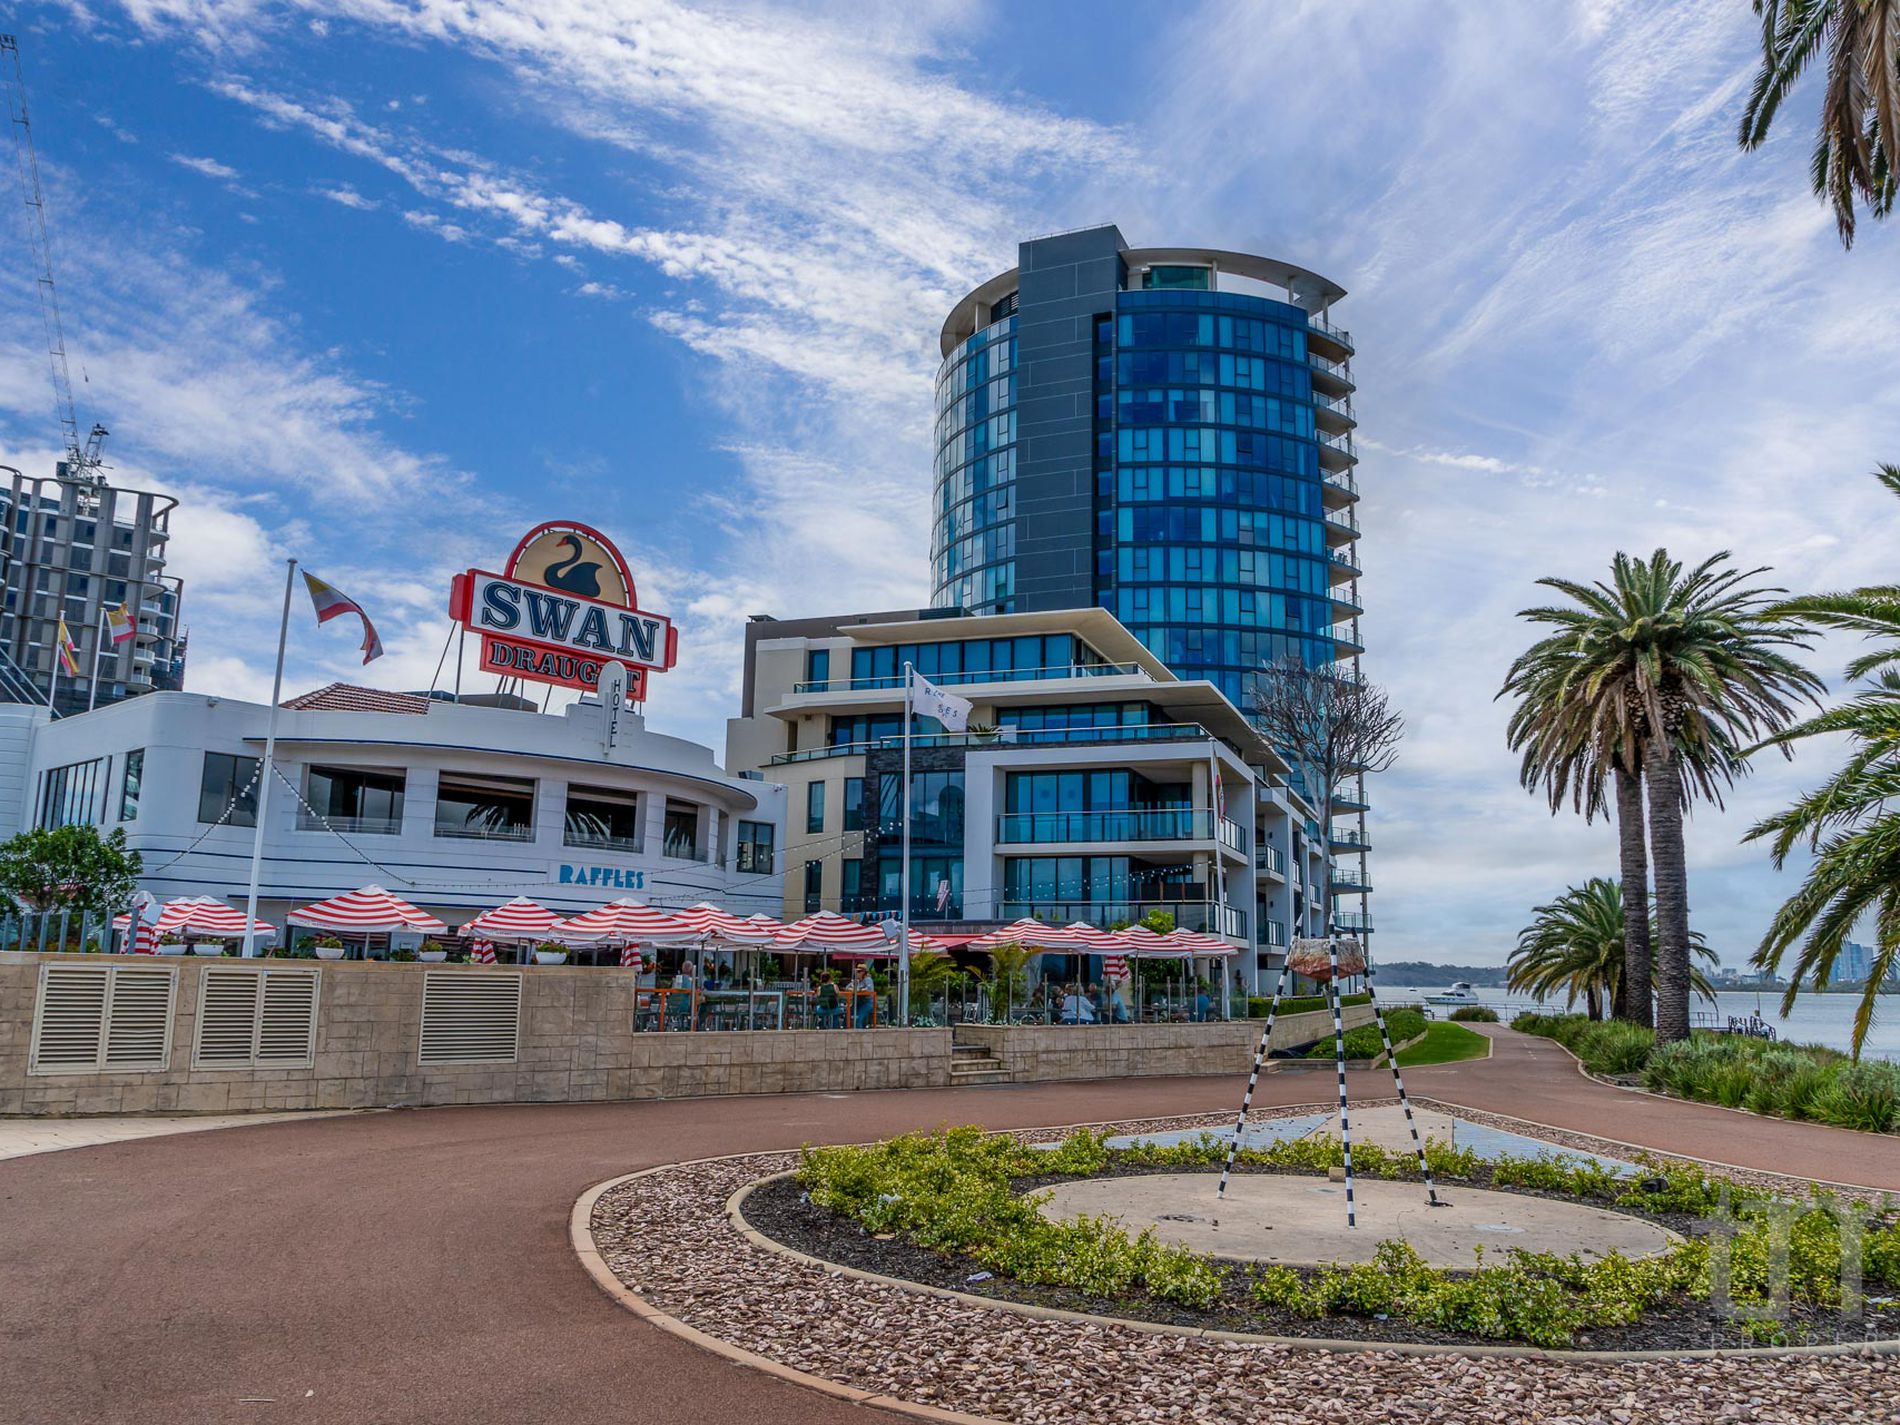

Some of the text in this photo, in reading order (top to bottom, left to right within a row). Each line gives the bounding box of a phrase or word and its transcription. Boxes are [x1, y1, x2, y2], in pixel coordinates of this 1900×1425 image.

[481, 580, 660, 662] SWAN
[491, 641, 641, 693] DRAUGT
[609, 678, 621, 748] HOTEL
[560, 864, 644, 889] RAFFLES
